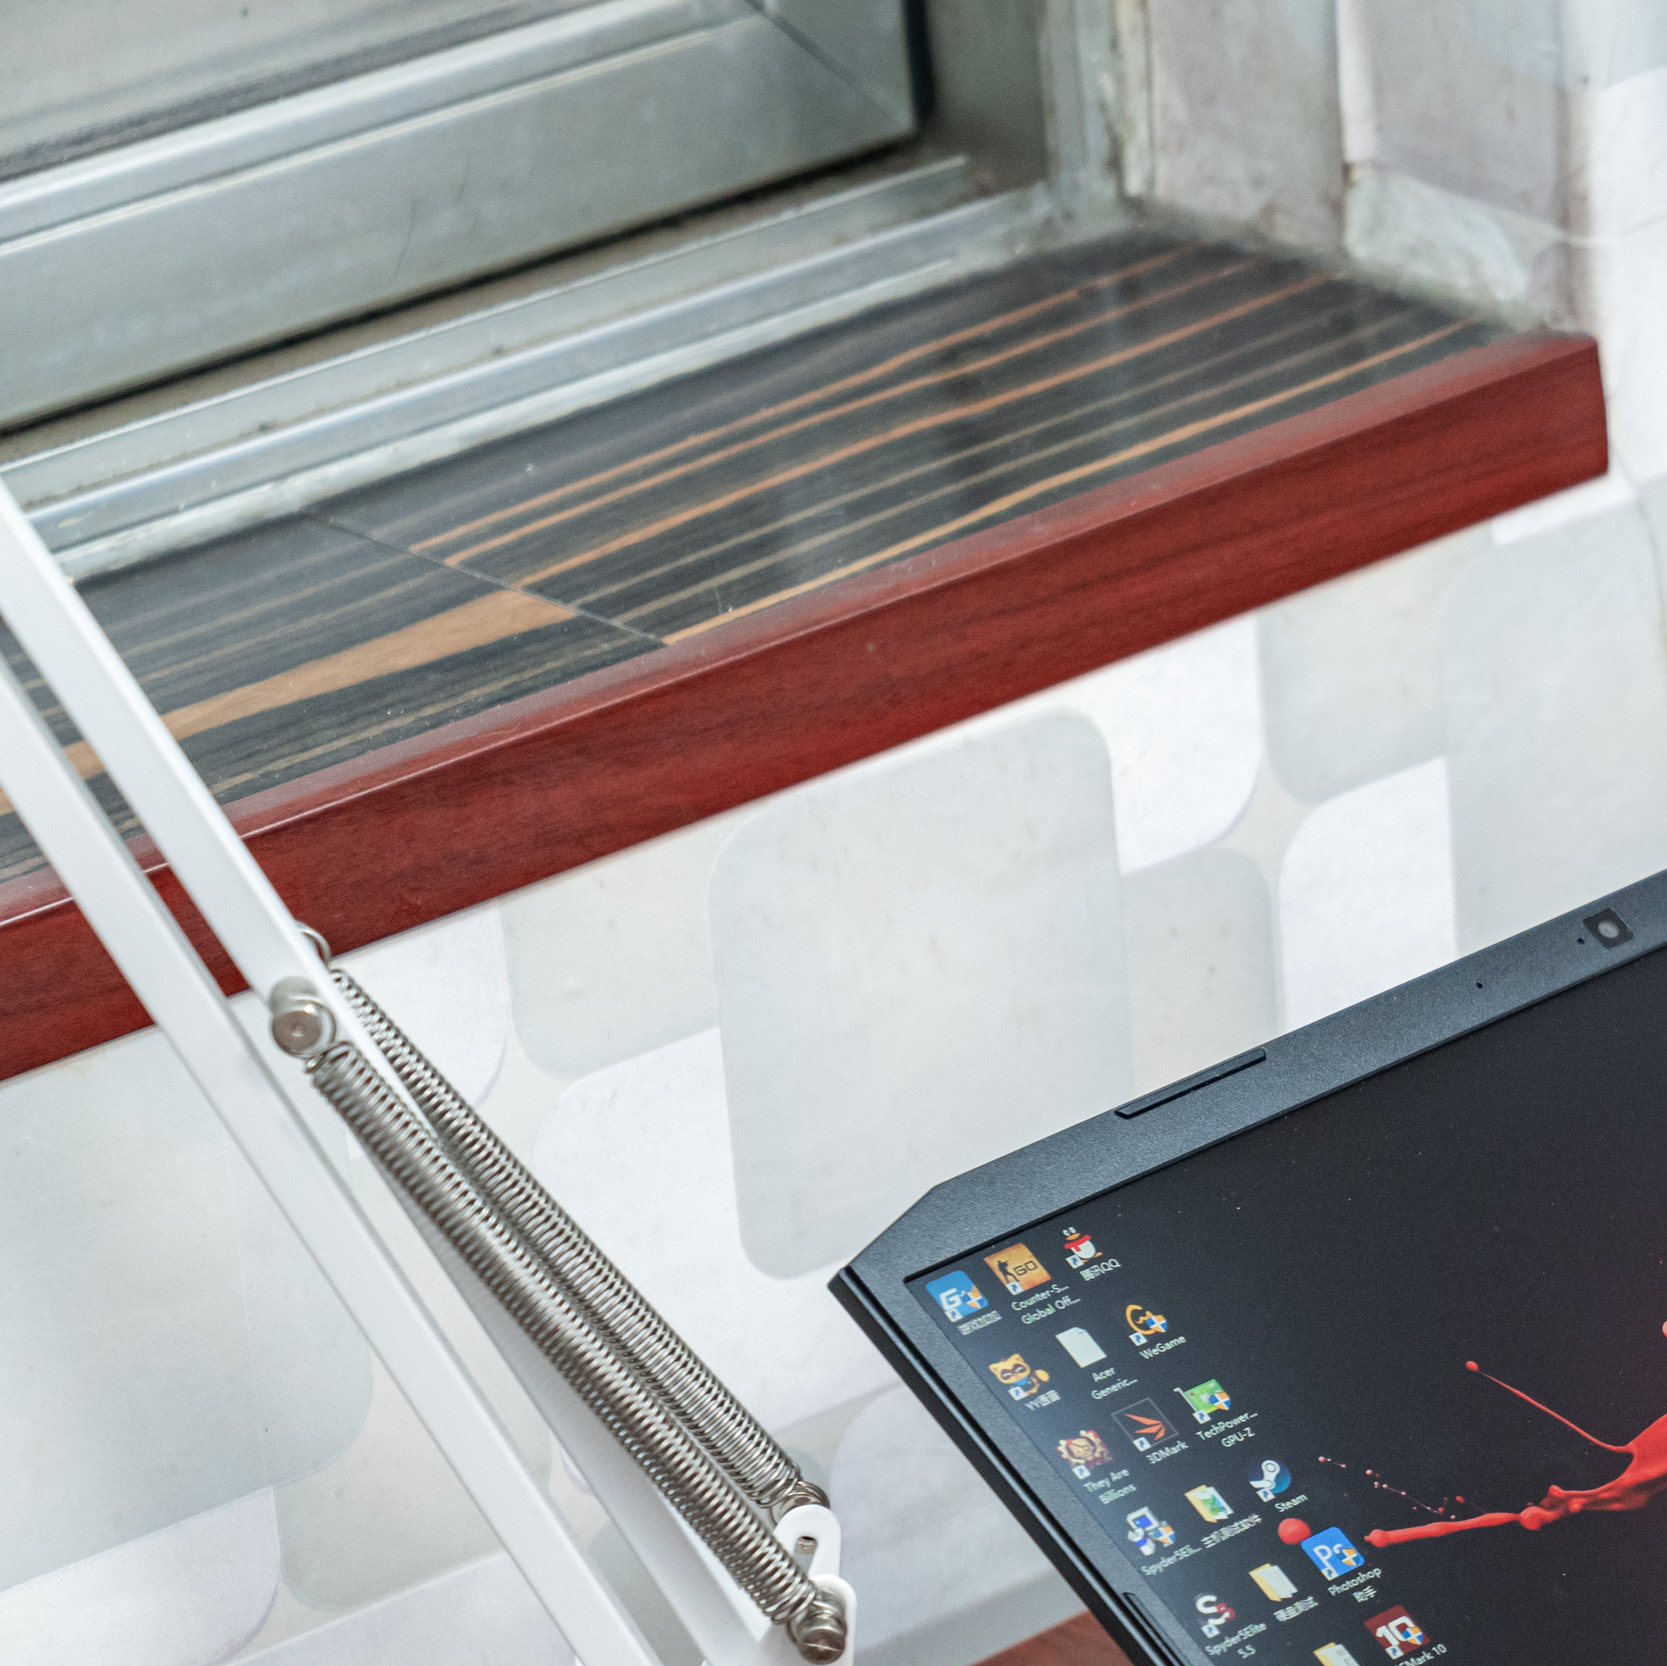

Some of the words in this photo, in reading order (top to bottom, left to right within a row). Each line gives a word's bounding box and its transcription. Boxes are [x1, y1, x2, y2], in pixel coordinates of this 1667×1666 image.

[1020, 1302, 1057, 1326] Global
[1138, 1335, 1187, 1360] WeGame
[1090, 1366, 1116, 1383] Acer
[1220, 1425, 1257, 1449] GPU-Z
[1145, 1439, 1190, 1466] 3DMark
[1081, 1477, 1112, 1493] They
[1108, 1468, 1131, 1483] Are
[1097, 1483, 1138, 1506] Billions
[1273, 1493, 1309, 1514] Steam
[1326, 1566, 1383, 1598] Photoshop
[1426, 1642, 1448, 1660] 10
